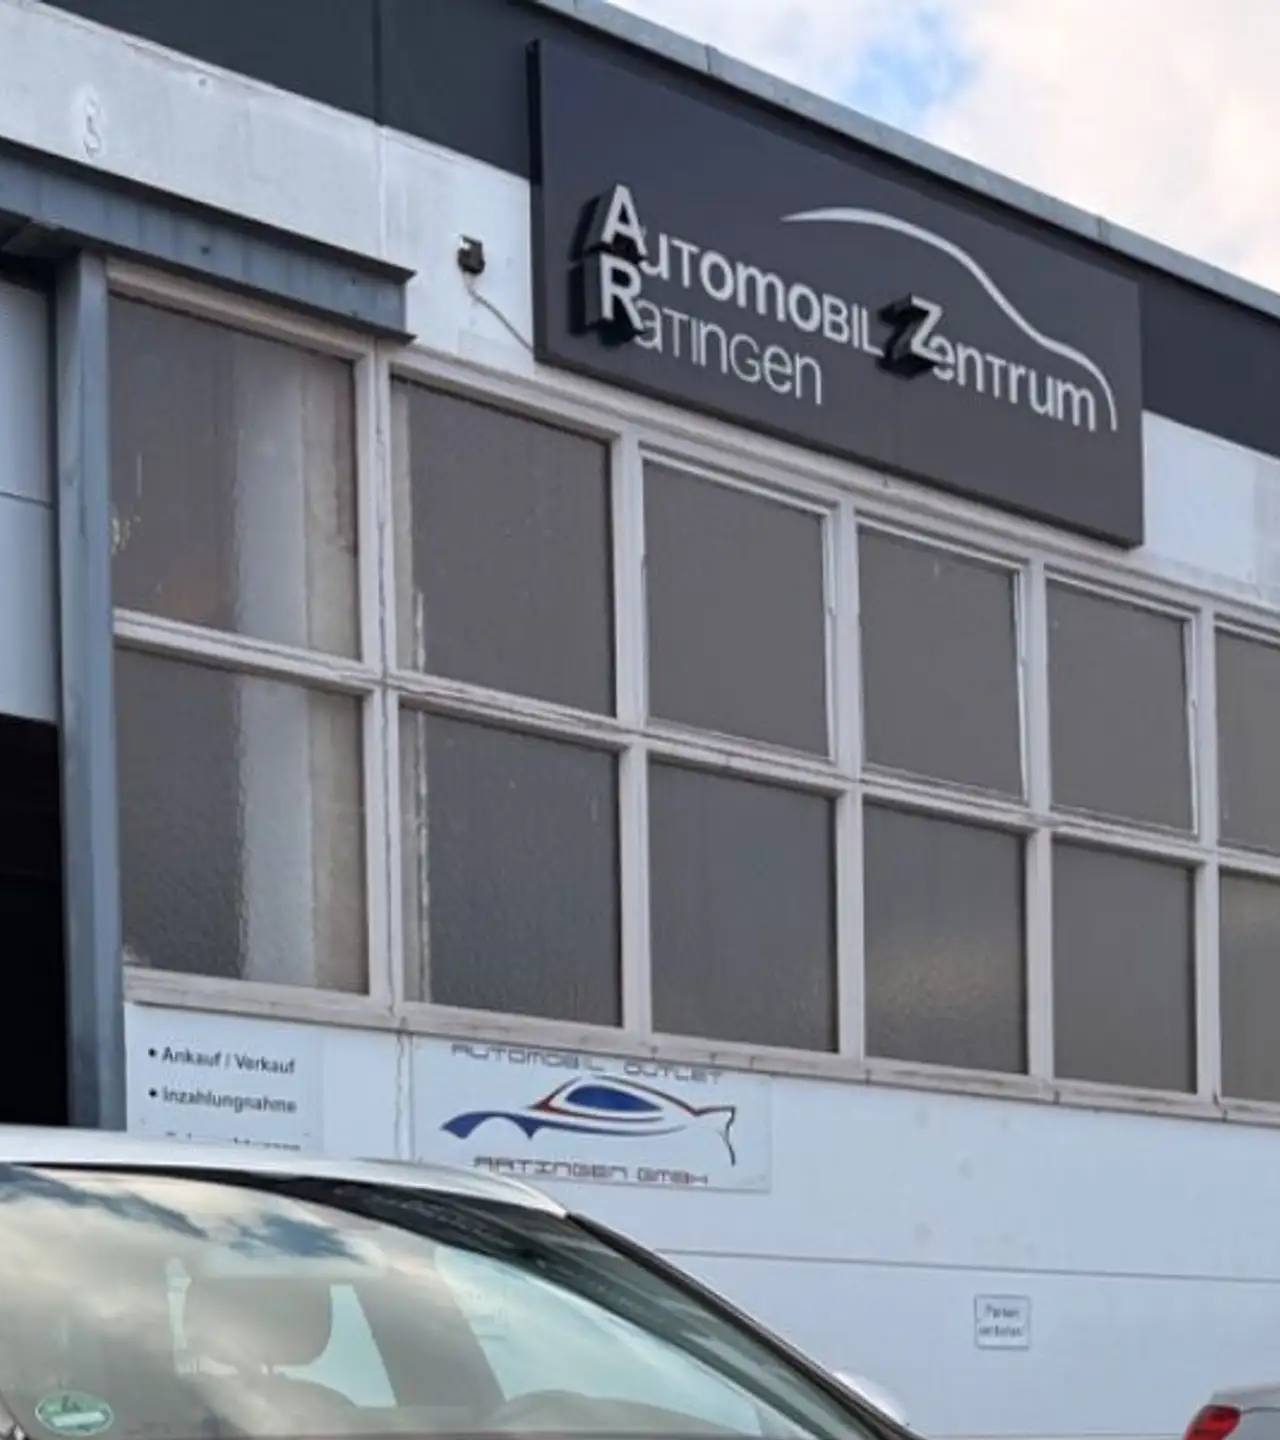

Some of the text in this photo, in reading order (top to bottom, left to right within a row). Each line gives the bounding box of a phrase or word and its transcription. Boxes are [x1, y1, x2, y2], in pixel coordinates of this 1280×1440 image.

[162, 1046, 222, 1068] Ankauf
[233, 1053, 297, 1075] Verkauf
[162, 1084, 298, 1114] Inzahlungnahme
